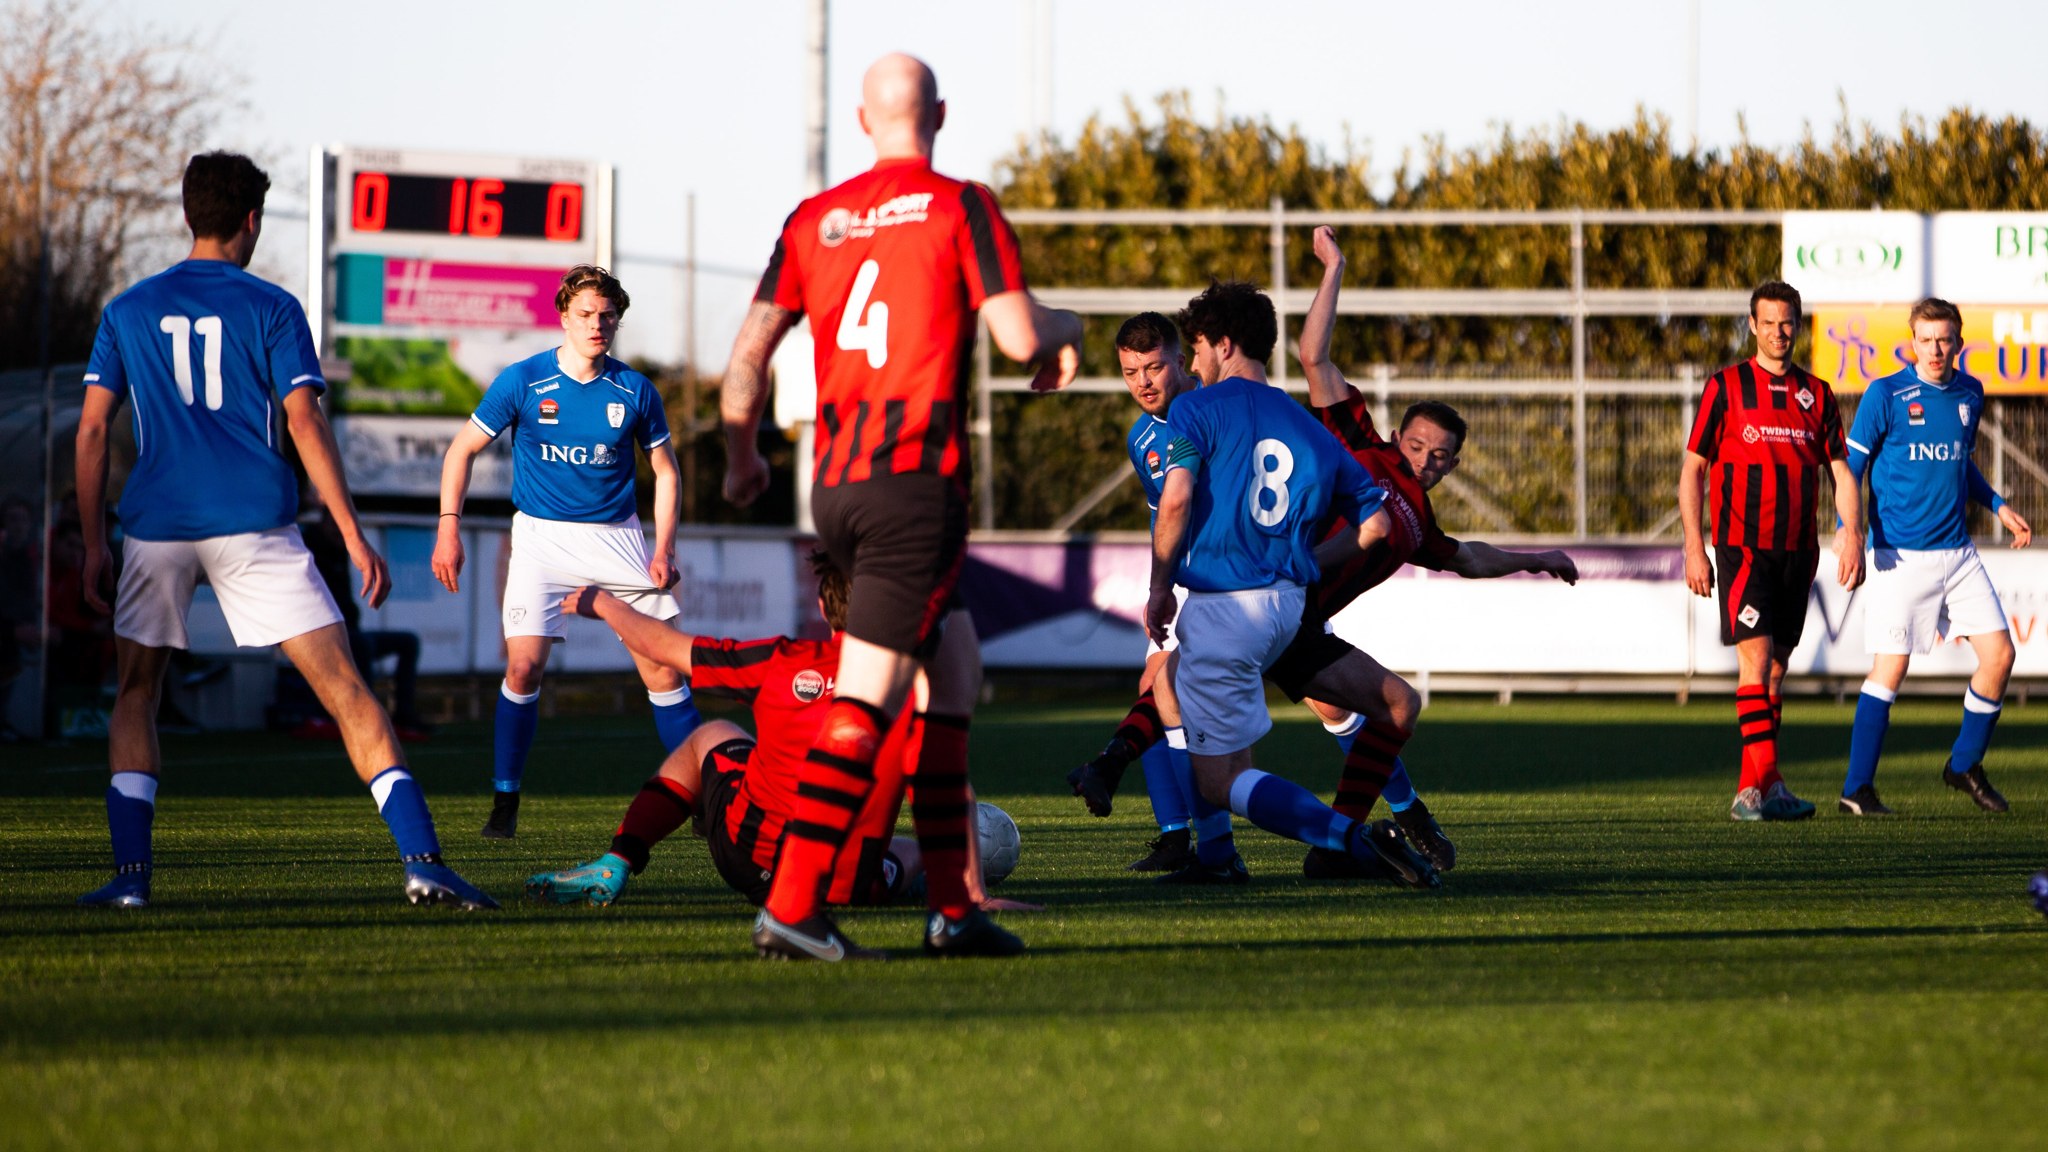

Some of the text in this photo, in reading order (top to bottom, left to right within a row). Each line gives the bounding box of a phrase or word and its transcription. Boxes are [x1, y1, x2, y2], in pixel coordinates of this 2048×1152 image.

[352, 171, 583, 241] 0 16 0
[836, 259, 889, 369] 4
[160, 315, 223, 411] 11
[540, 444, 588, 465] ING
[1250, 438, 1294, 526] 8
[1908, 443, 1949, 461] ING
